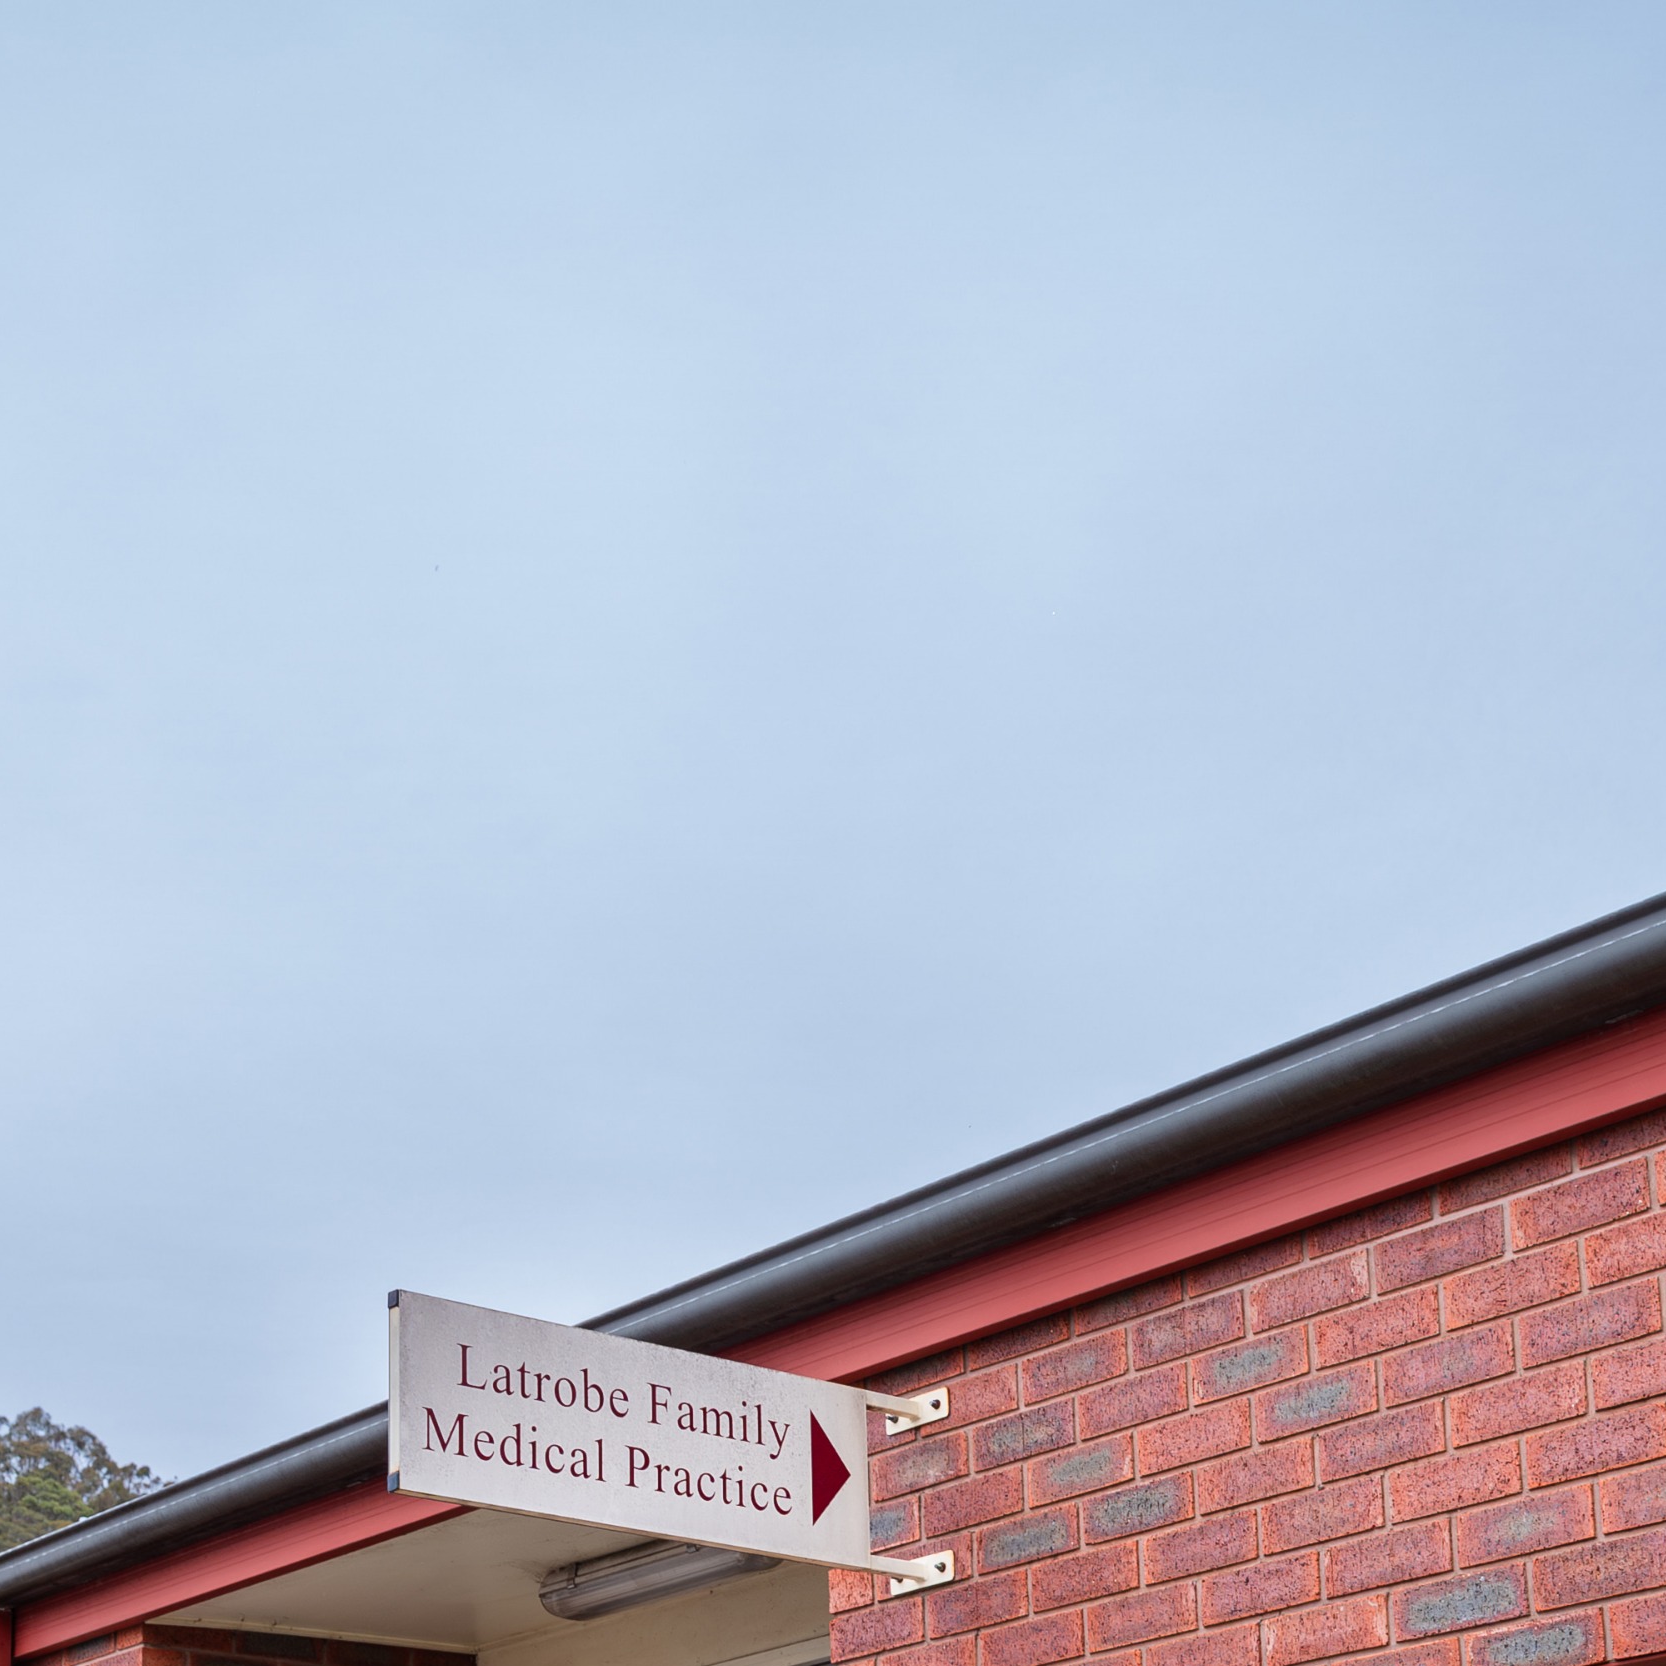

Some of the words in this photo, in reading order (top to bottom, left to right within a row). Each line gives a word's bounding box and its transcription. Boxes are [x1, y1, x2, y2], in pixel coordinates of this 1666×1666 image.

[456, 1343, 629, 1418] Latrobe
[647, 1383, 791, 1460] Family
[422, 1407, 605, 1483] Medical
[624, 1445, 793, 1516] Practice
